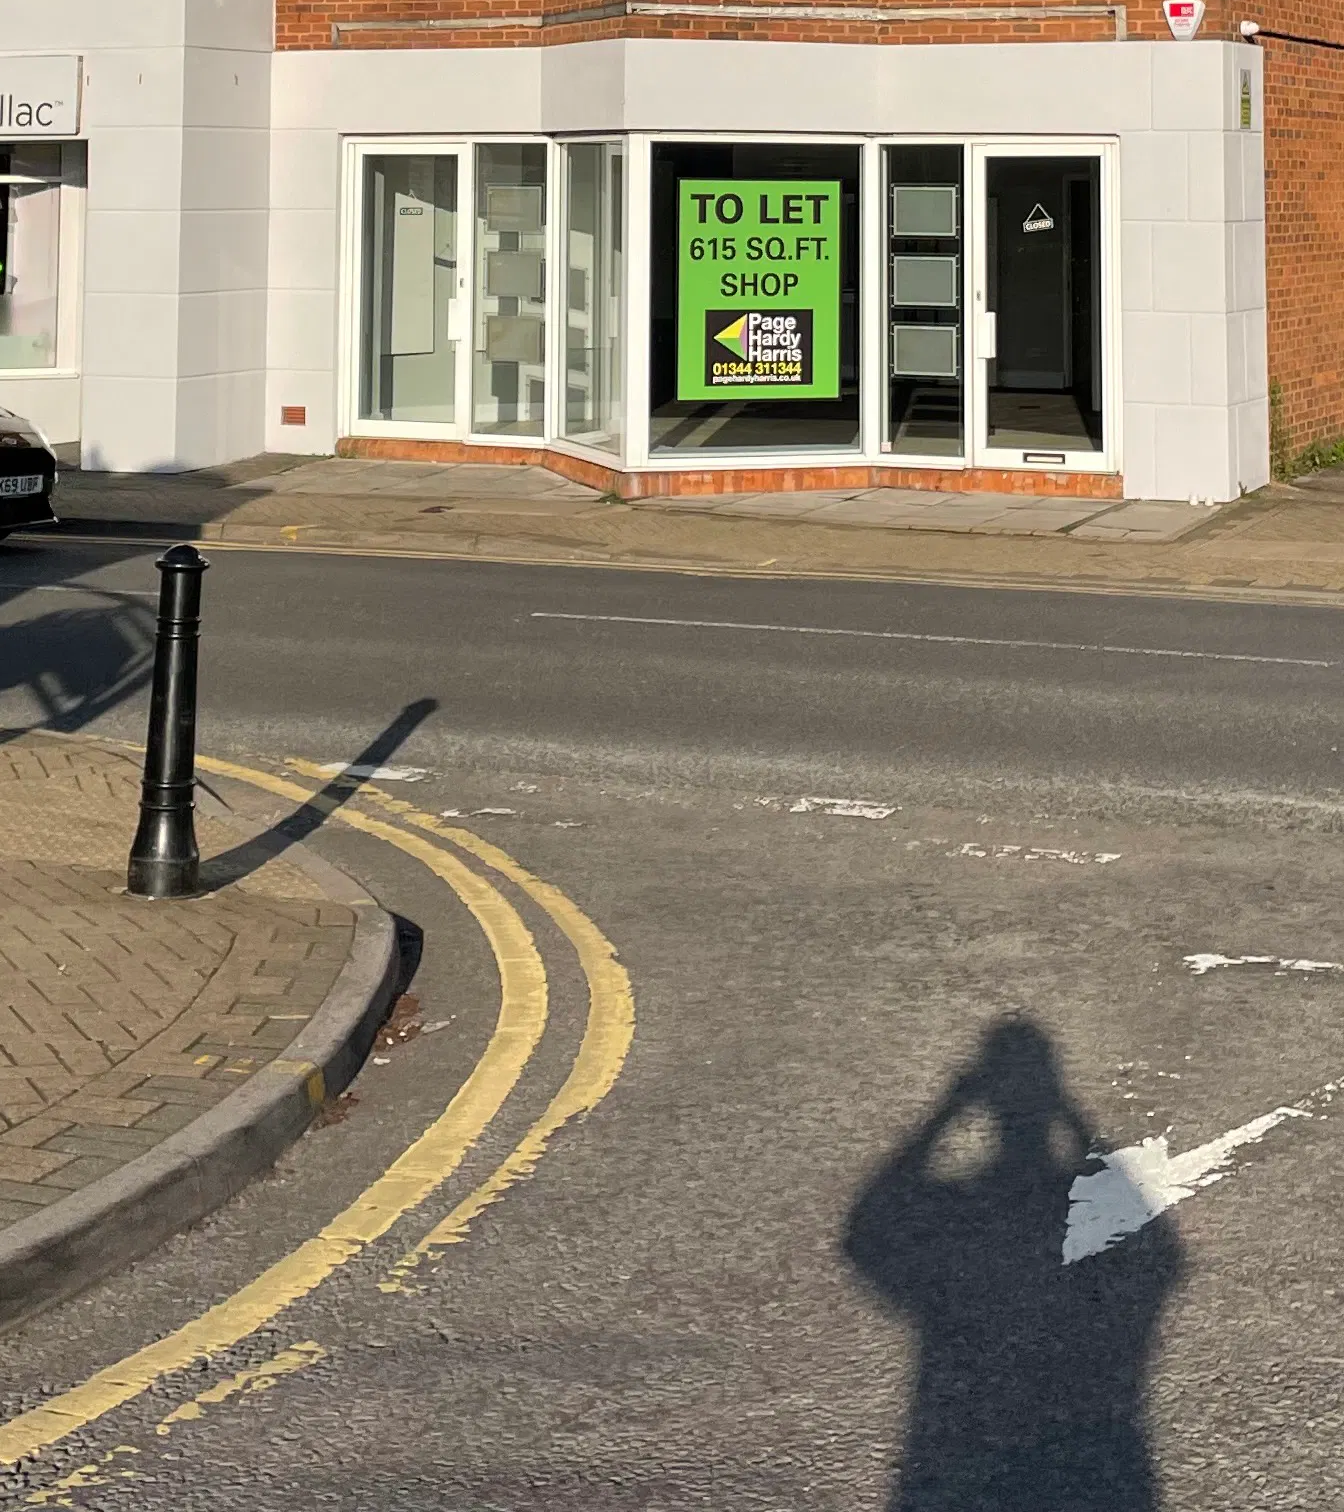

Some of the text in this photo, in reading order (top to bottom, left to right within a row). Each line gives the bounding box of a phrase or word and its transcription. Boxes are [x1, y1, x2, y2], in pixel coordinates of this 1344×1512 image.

[690, 193, 829, 224] TO LET
[1025, 220, 1051, 231] CLOSED
[689, 236, 830, 260] 615 SQ.FT.
[720, 273, 799, 297] SHOP
[748, 313, 797, 333] Page
[748, 329, 801, 349] Hardy
[748, 346, 802, 362] Harris
[713, 362, 802, 375] 01344 311344
[713, 374, 802, 384] pagehardyharris.co.uk
